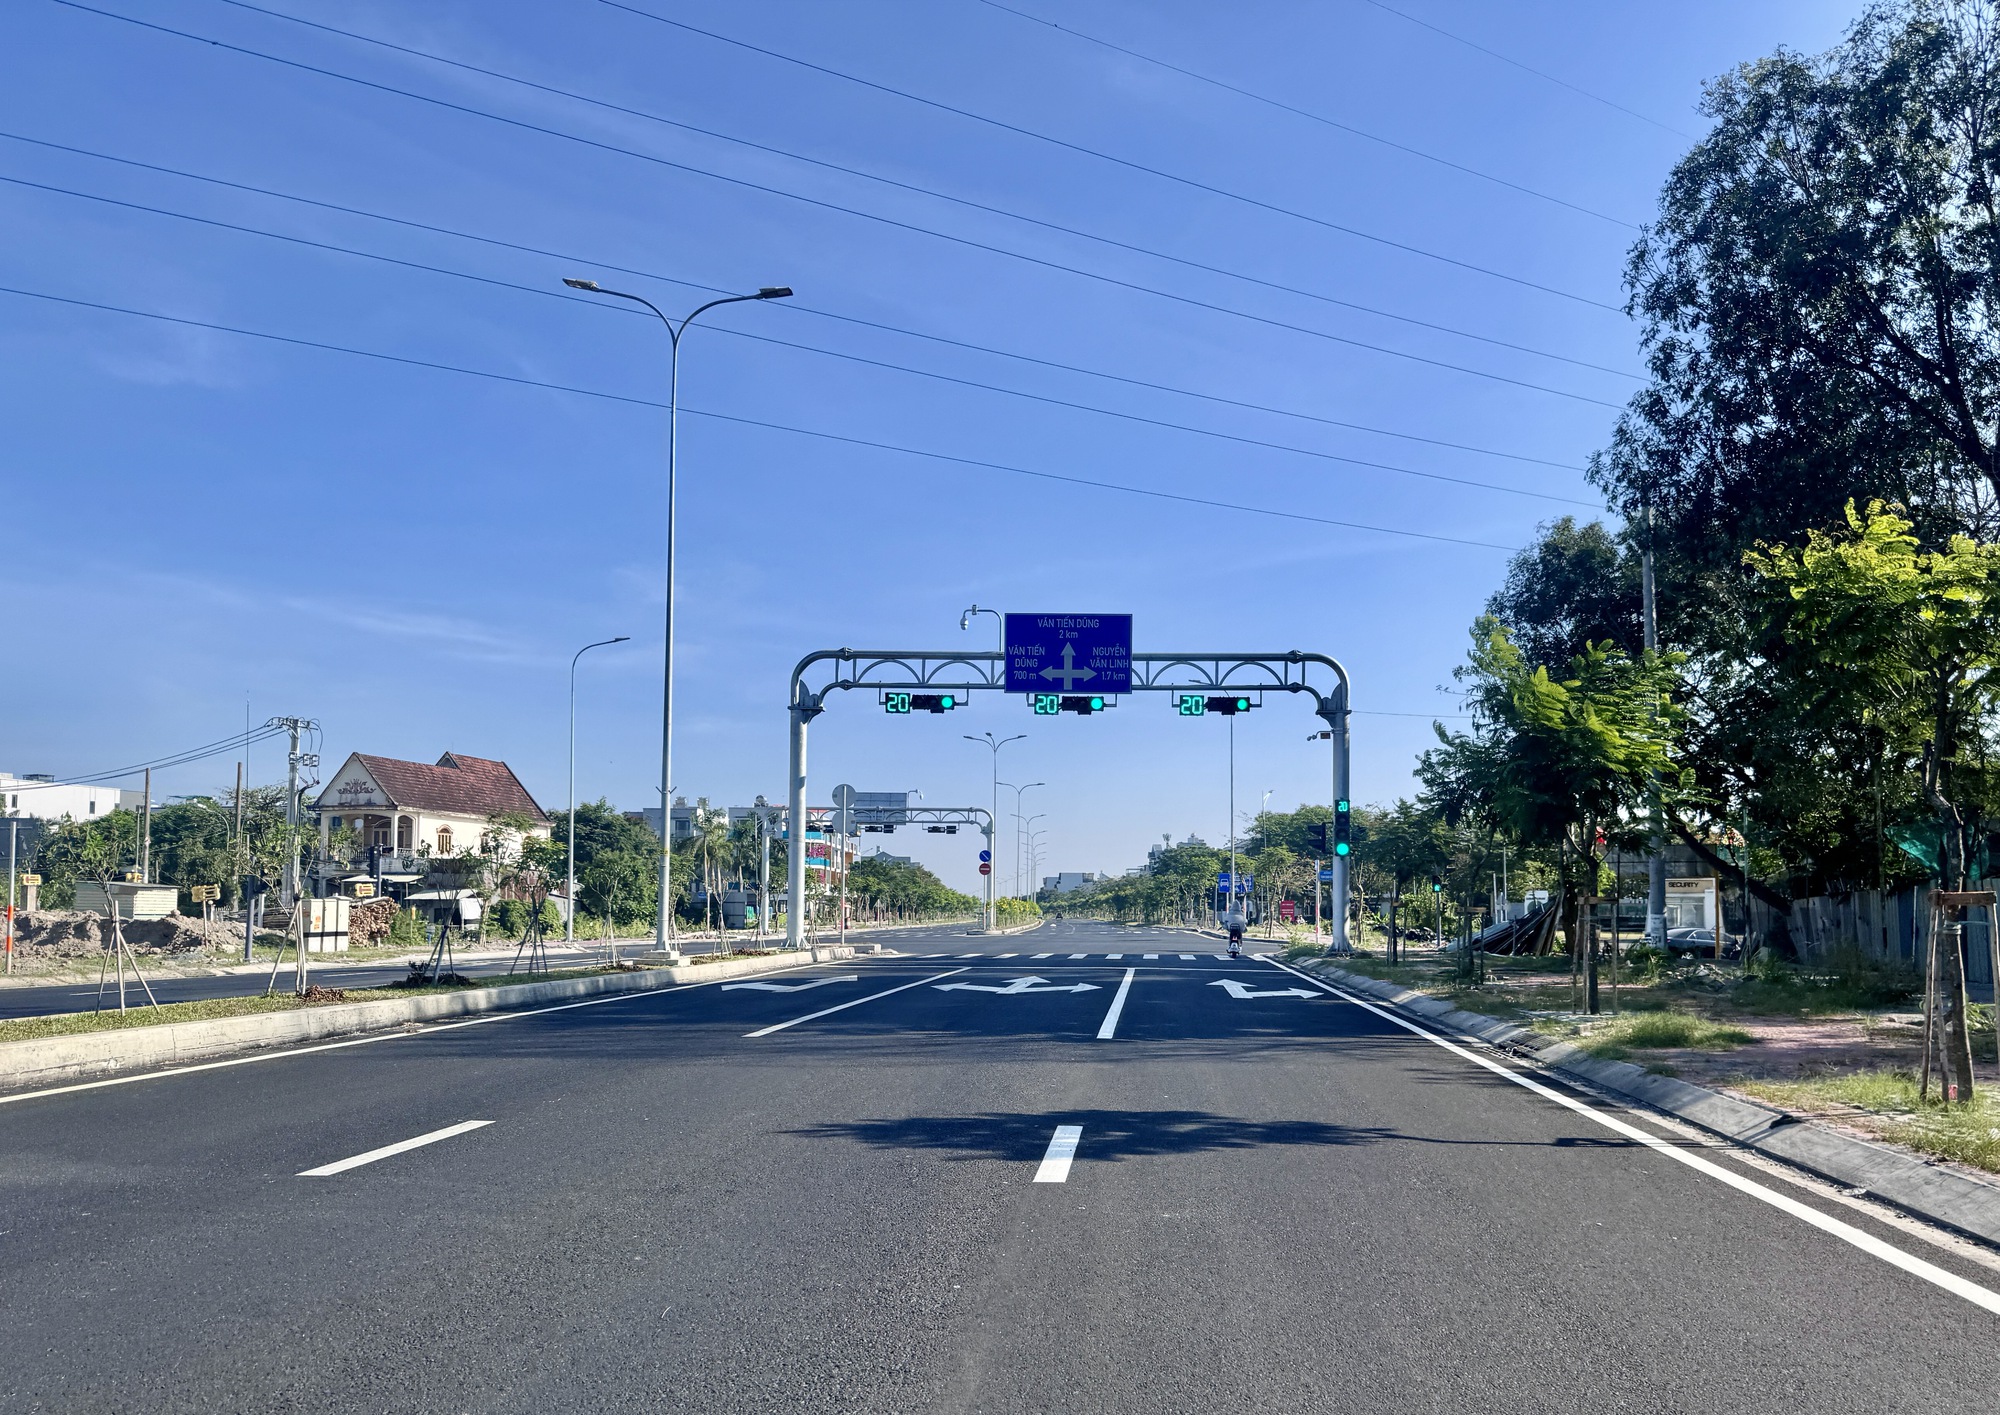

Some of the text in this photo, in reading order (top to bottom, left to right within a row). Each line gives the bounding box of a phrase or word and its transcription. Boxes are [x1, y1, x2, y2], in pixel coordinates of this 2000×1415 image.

[1056, 616, 1075, 628] TIẾN
[1059, 630, 1078, 638] 2 km
[1008, 643, 1045, 656] VĂN TIẾN
[1090, 658, 1129, 668] VĂN LINH
[1014, 671, 1027, 680] 700
[1101, 671, 1126, 680] 1.7 km
[887, 694, 908, 712] 20
[1035, 695, 1057, 713] 20
[1181, 696, 1203, 714] 20
[1338, 801, 1348, 812] 20
